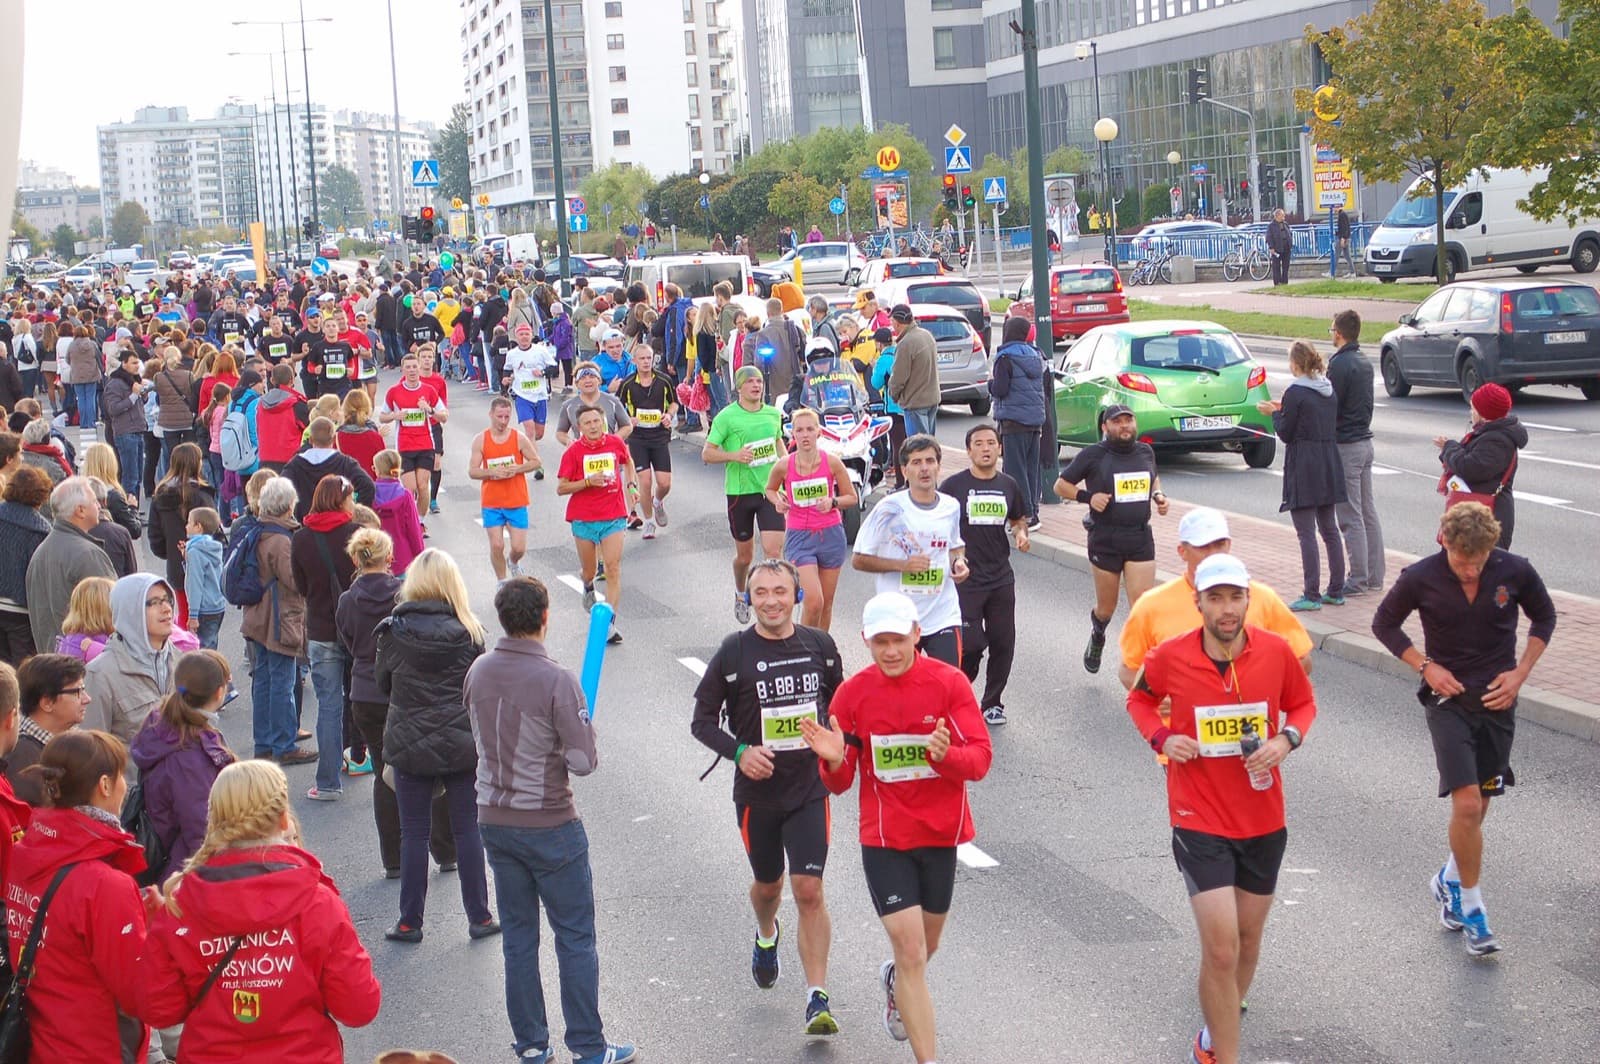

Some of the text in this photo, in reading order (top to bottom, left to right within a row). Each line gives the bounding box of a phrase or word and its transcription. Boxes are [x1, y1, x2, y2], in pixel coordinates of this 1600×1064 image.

[1315, 172, 1341, 181] WIELKI
[1323, 179, 1350, 190] WYBÓR
[753, 444, 774, 457] 2064
[589, 459, 608, 470] 6728
[1122, 479, 1146, 489] 4125
[797, 486, 823, 497] 4094
[973, 502, 1003, 513] 10201
[882, 746, 927, 764] 9498
